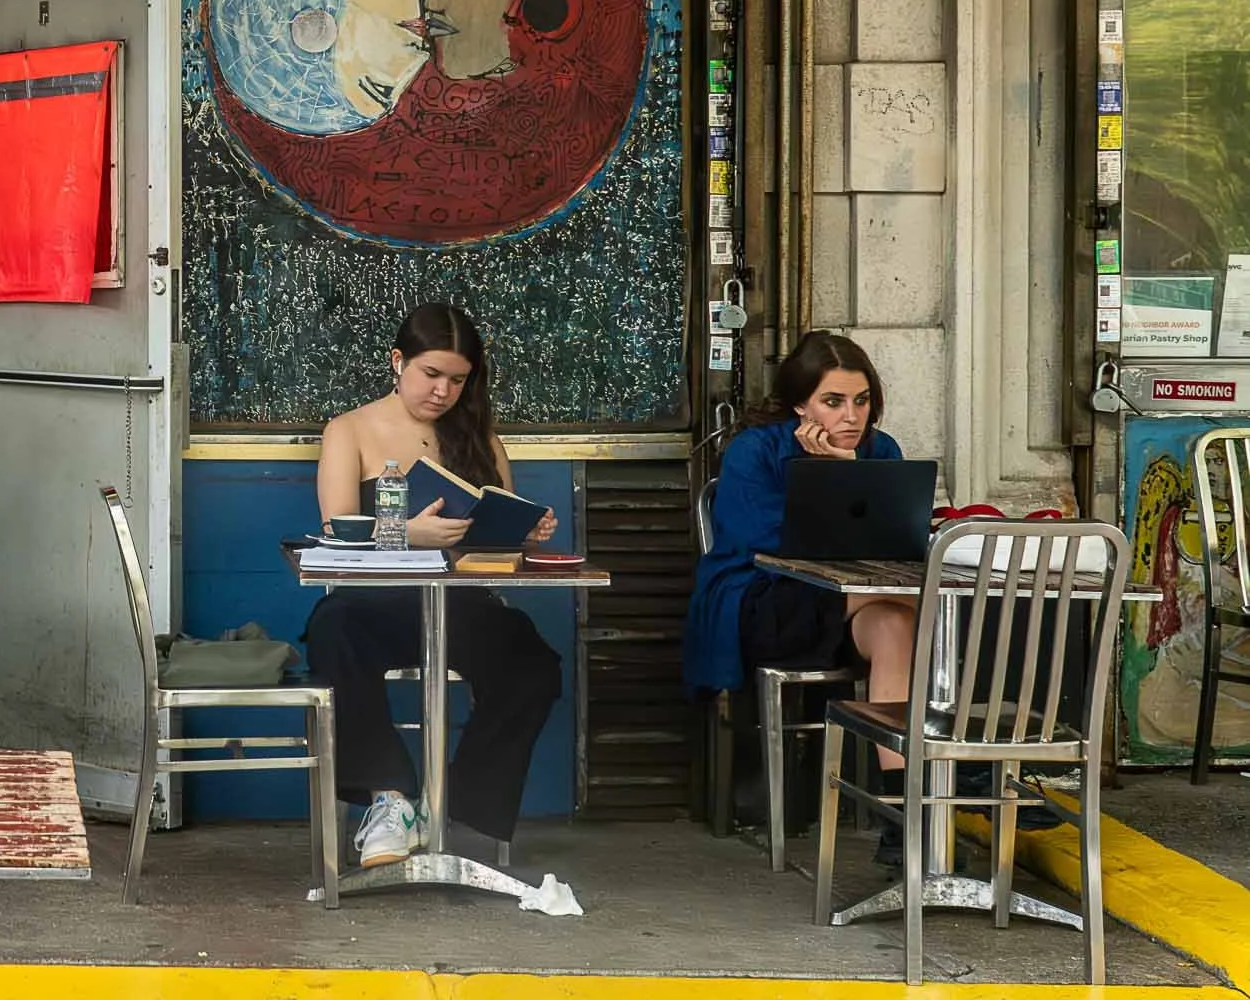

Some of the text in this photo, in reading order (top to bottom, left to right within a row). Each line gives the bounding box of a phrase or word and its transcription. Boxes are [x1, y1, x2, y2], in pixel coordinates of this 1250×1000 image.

[1170, 321, 1200, 329] AWARD
[1150, 334, 1181, 343] Pastry
[1183, 334, 1208, 343] Shop
[1156, 384, 1232, 398] NO SMOKING
